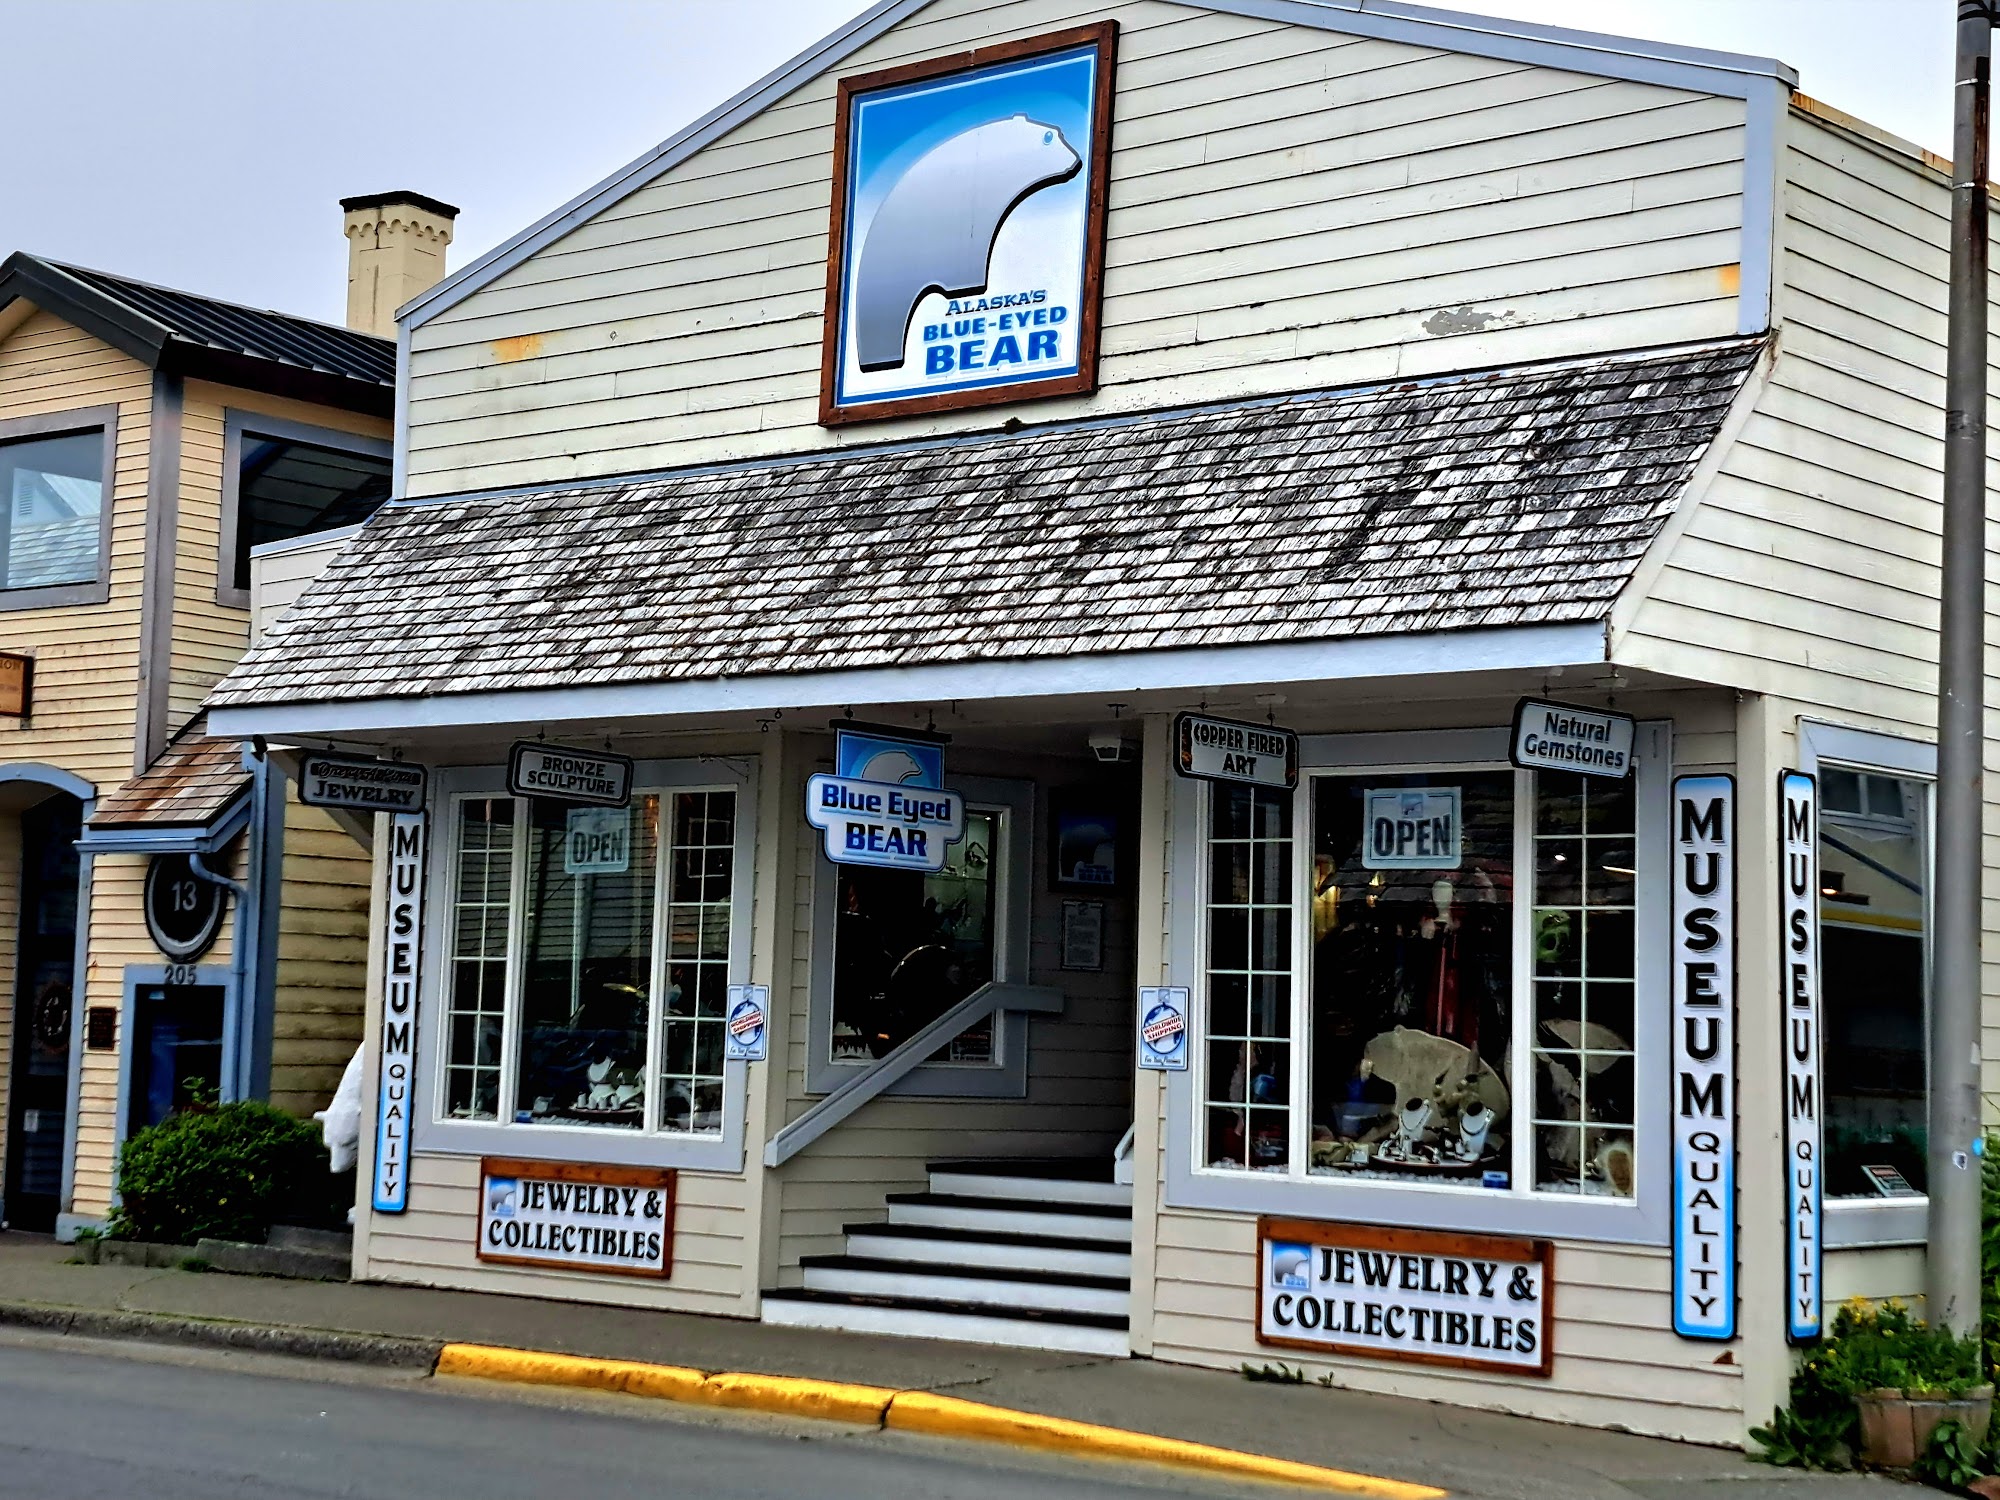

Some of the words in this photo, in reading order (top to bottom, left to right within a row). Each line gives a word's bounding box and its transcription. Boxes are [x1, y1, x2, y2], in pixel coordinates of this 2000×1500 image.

[945, 289, 1047, 317] ALASKA'S
[923, 305, 1069, 343] BLUE-EYED
[925, 329, 1060, 376] BEAR
[1193, 721, 1244, 750] COPPER
[1247, 731, 1286, 757] FIRED
[1544, 711, 1612, 743] Natural
[541, 756, 606, 778] BRONZE
[1222, 752, 1257, 777] ART
[1524, 733, 1625, 768] Gemstones
[313, 780, 415, 805] JEWELRY
[527, 770, 616, 794] SCULPTURE
[822, 783, 882, 813] Blue
[888, 791, 951, 824] Eyed
[572, 828, 624, 864] OPEN
[846, 822, 928, 857] BEAR
[1373, 813, 1451, 857] OPEN
[171, 880, 198, 912] 13
[384, 824, 421, 1056] MUSEUM
[1679, 797, 1728, 1120] MUSEUM
[1786, 797, 1815, 1120] MUSEUM
[164, 965, 197, 985] 205
[1143, 1016, 1182, 1035] WORLDWIDE
[1147, 1023, 1182, 1040] SHIPPING
[383, 1063, 405, 1199] QUALITY
[521, 1181, 639, 1217] JEWELRY
[643, 1189, 663, 1219] &
[488, 1219, 661, 1261] COLLECTIBLES
[1688, 1130, 1720, 1318] QUALITY
[1795, 1138, 1812, 1318] QUALITY
[1319, 1247, 1499, 1298] JEWELRY
[1507, 1265, 1538, 1301] &
[1272, 1293, 1537, 1354] COLLECTIBLES
